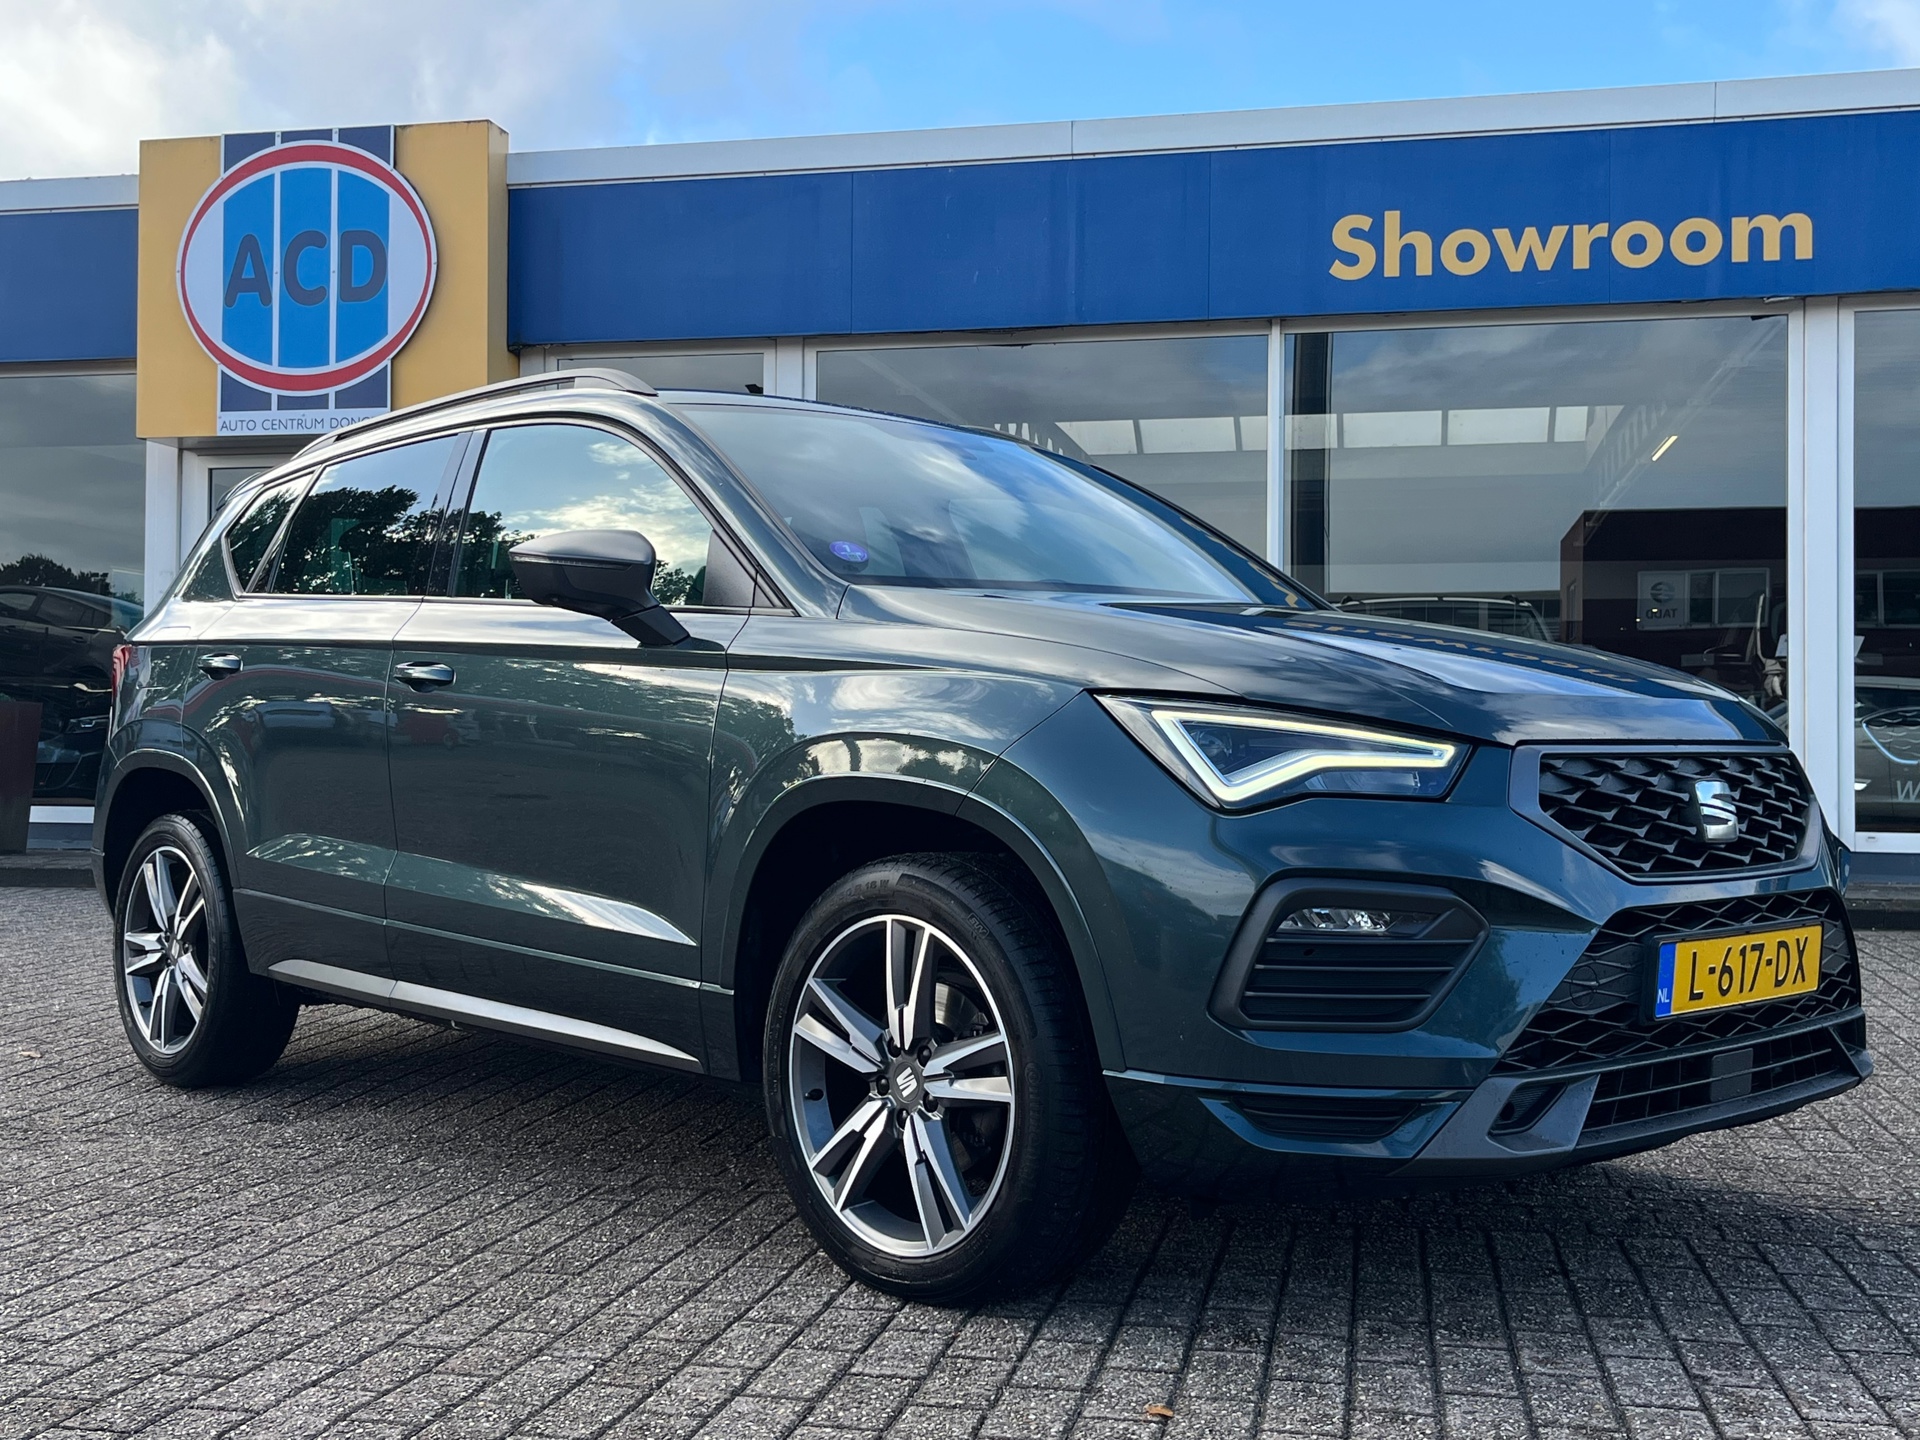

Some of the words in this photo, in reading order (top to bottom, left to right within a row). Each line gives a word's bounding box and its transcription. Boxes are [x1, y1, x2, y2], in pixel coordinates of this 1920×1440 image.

[1328, 210, 1814, 282] Showroom
[224, 230, 388, 308] ACD
[220, 419, 257, 432] AUTO
[261, 417, 325, 431] CENTRUM
[969, 917, 988, 935] SUV
[1688, 936, 1809, 1002] L-617-DX
[1656, 987, 1671, 1005] NL
